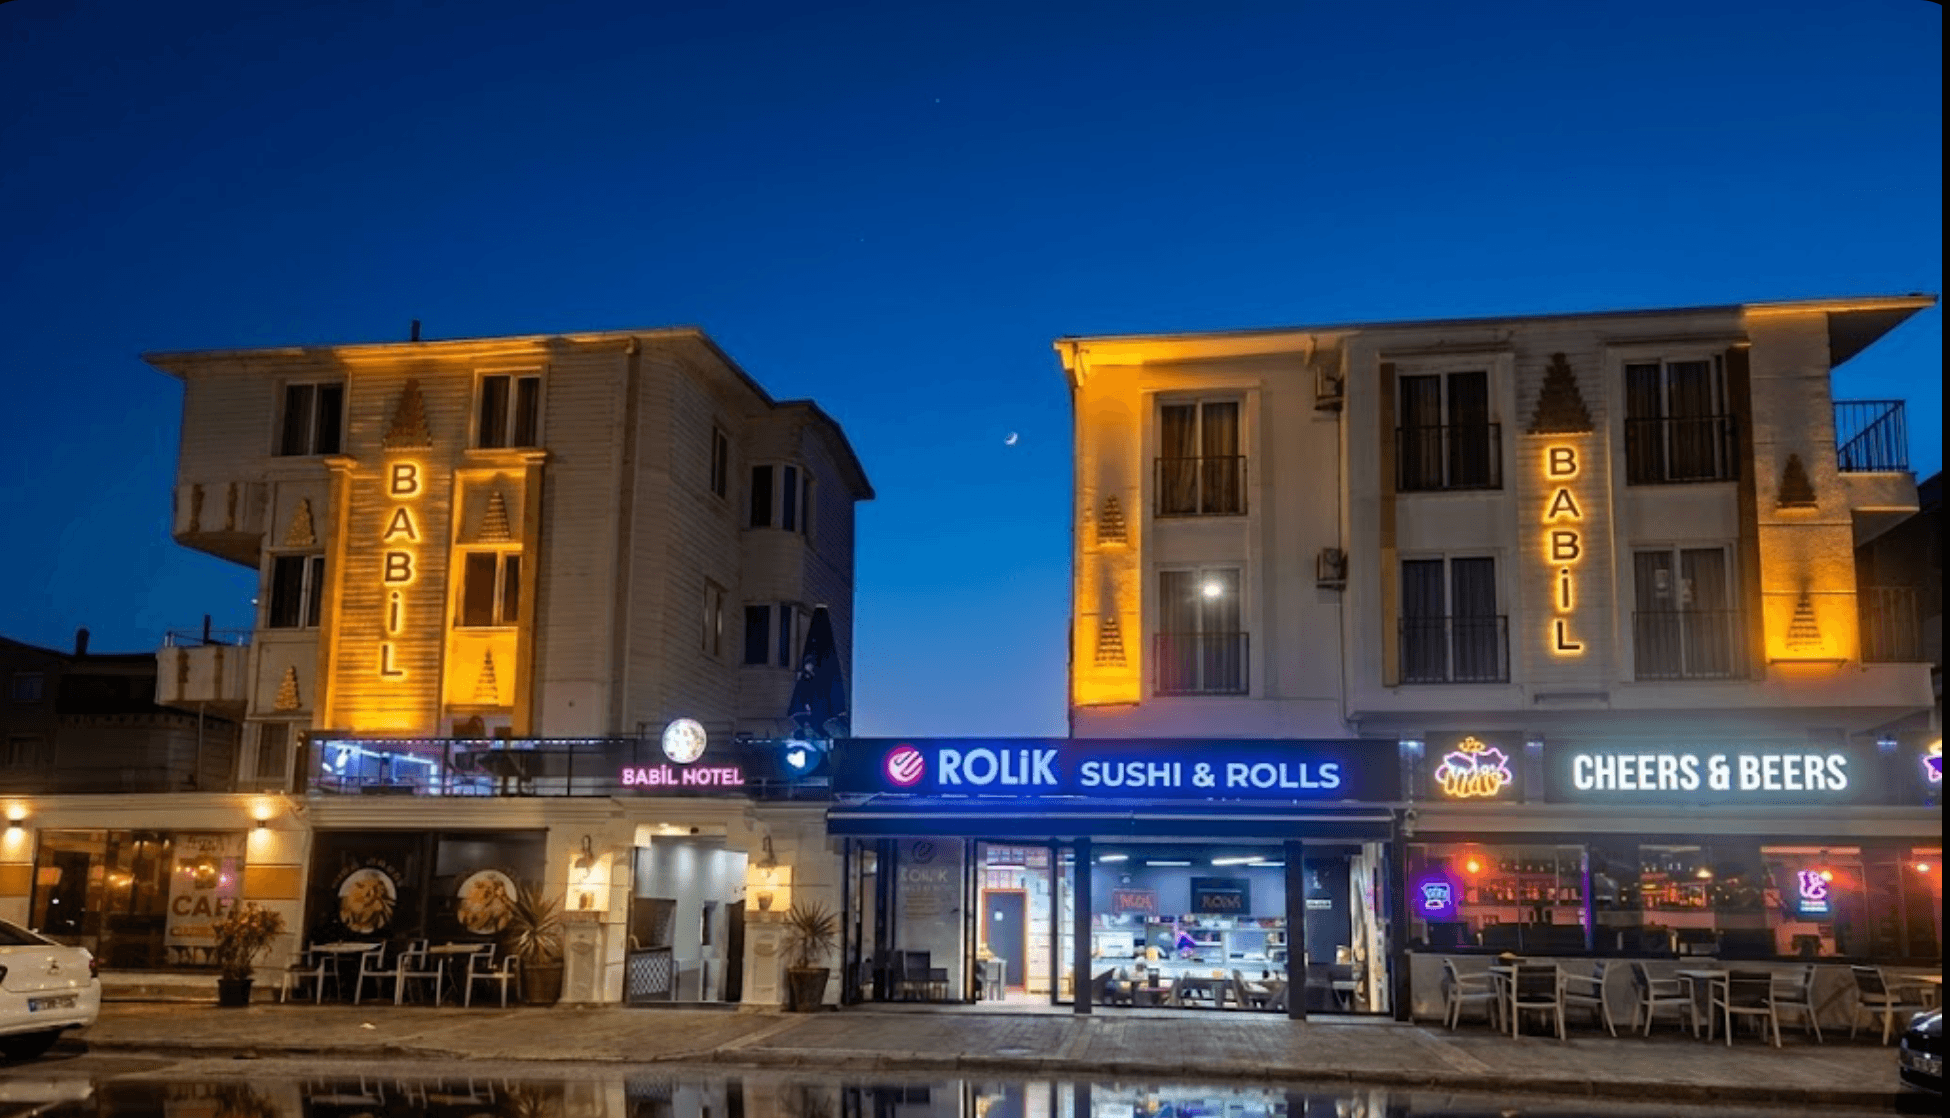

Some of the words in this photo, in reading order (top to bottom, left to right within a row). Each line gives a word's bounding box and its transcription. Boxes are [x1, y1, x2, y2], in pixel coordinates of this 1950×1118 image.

[682, 768, 744, 785] HOTEL
[1080, 762, 1181, 787] SUSHI
[1192, 762, 1216, 787] &
[1226, 763, 1340, 788] ROLLS
[1574, 754, 1700, 790] CHEERS
[1708, 755, 1730, 790] &
[1739, 754, 1848, 790] BEERS
[172, 895, 239, 917] CAF
